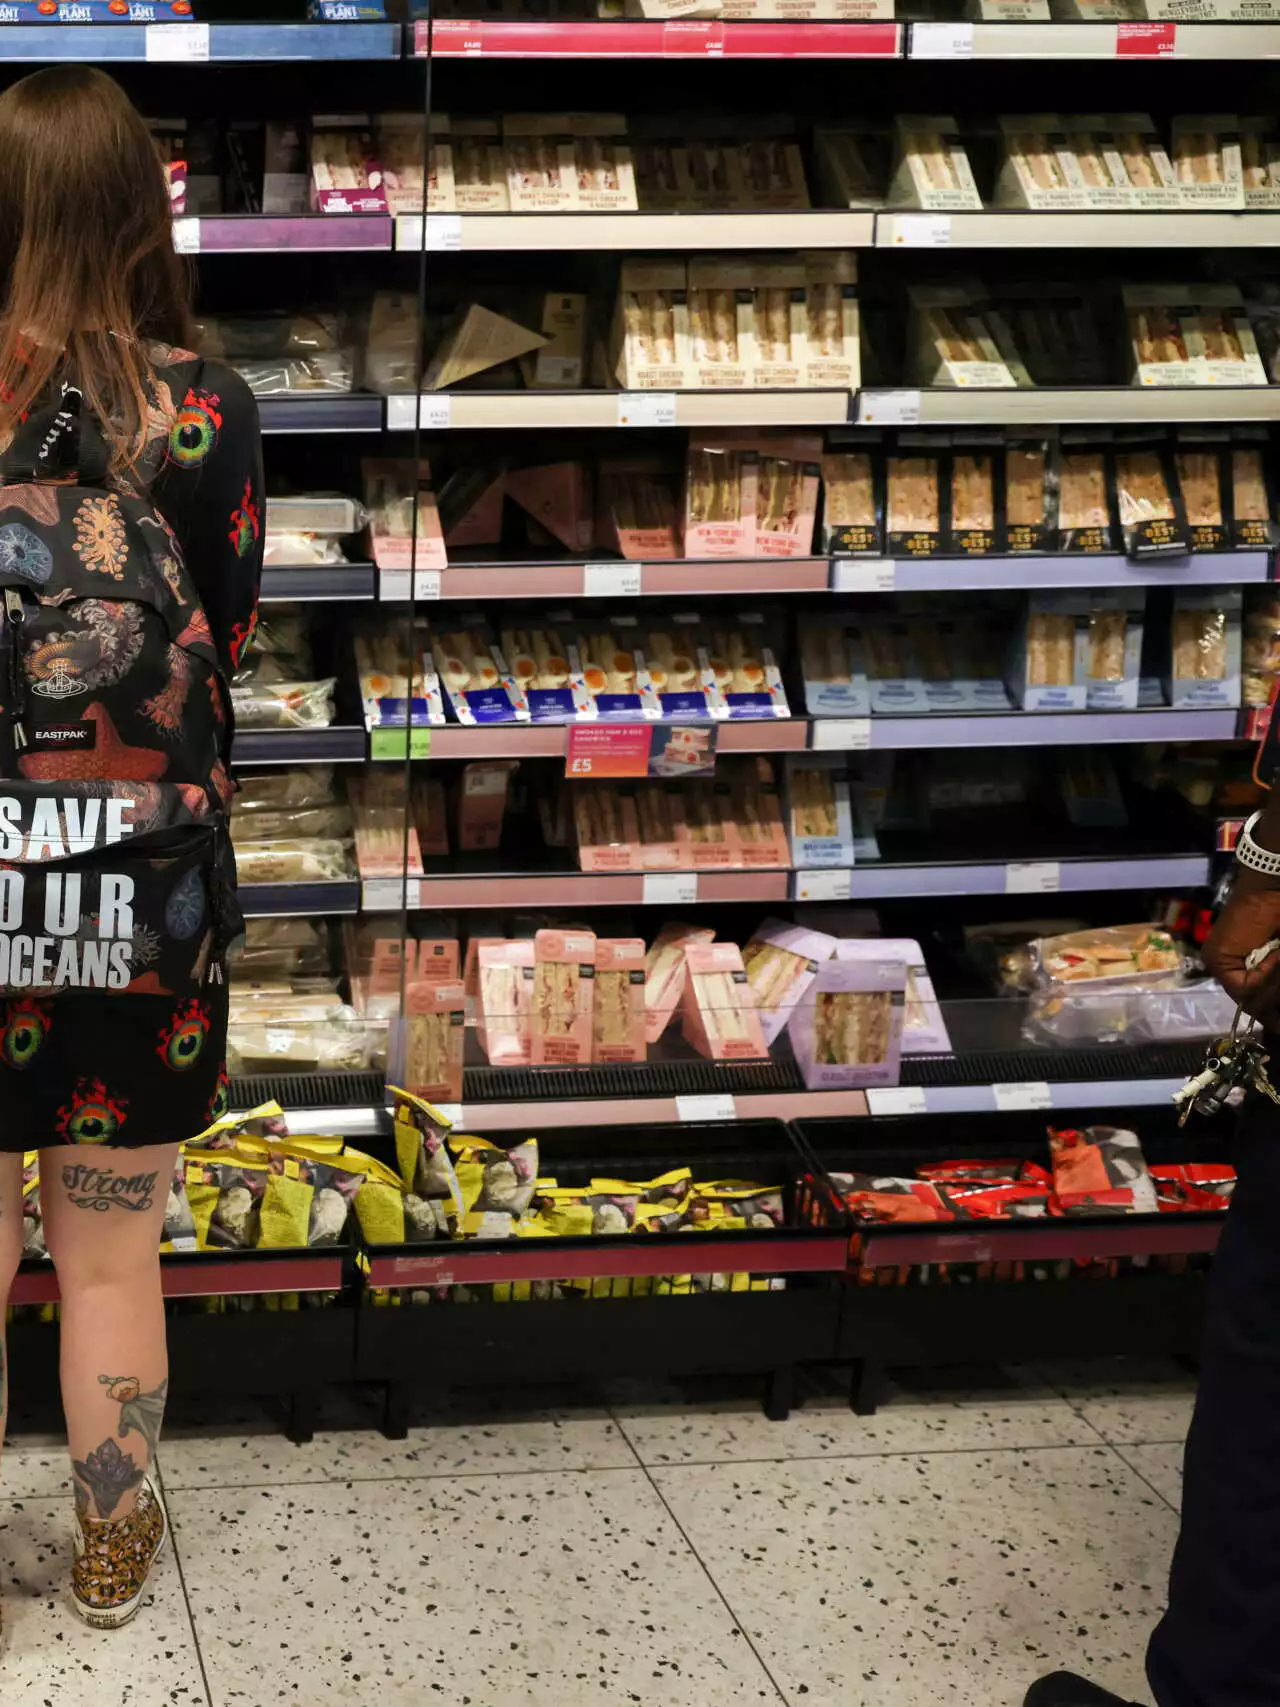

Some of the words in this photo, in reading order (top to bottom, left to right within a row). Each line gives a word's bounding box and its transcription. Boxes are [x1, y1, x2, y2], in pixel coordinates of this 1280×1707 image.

[35, 731, 84, 740] EASTPAK
[572, 758, 592, 773] £5
[62, 1164, 159, 1201] Strong
